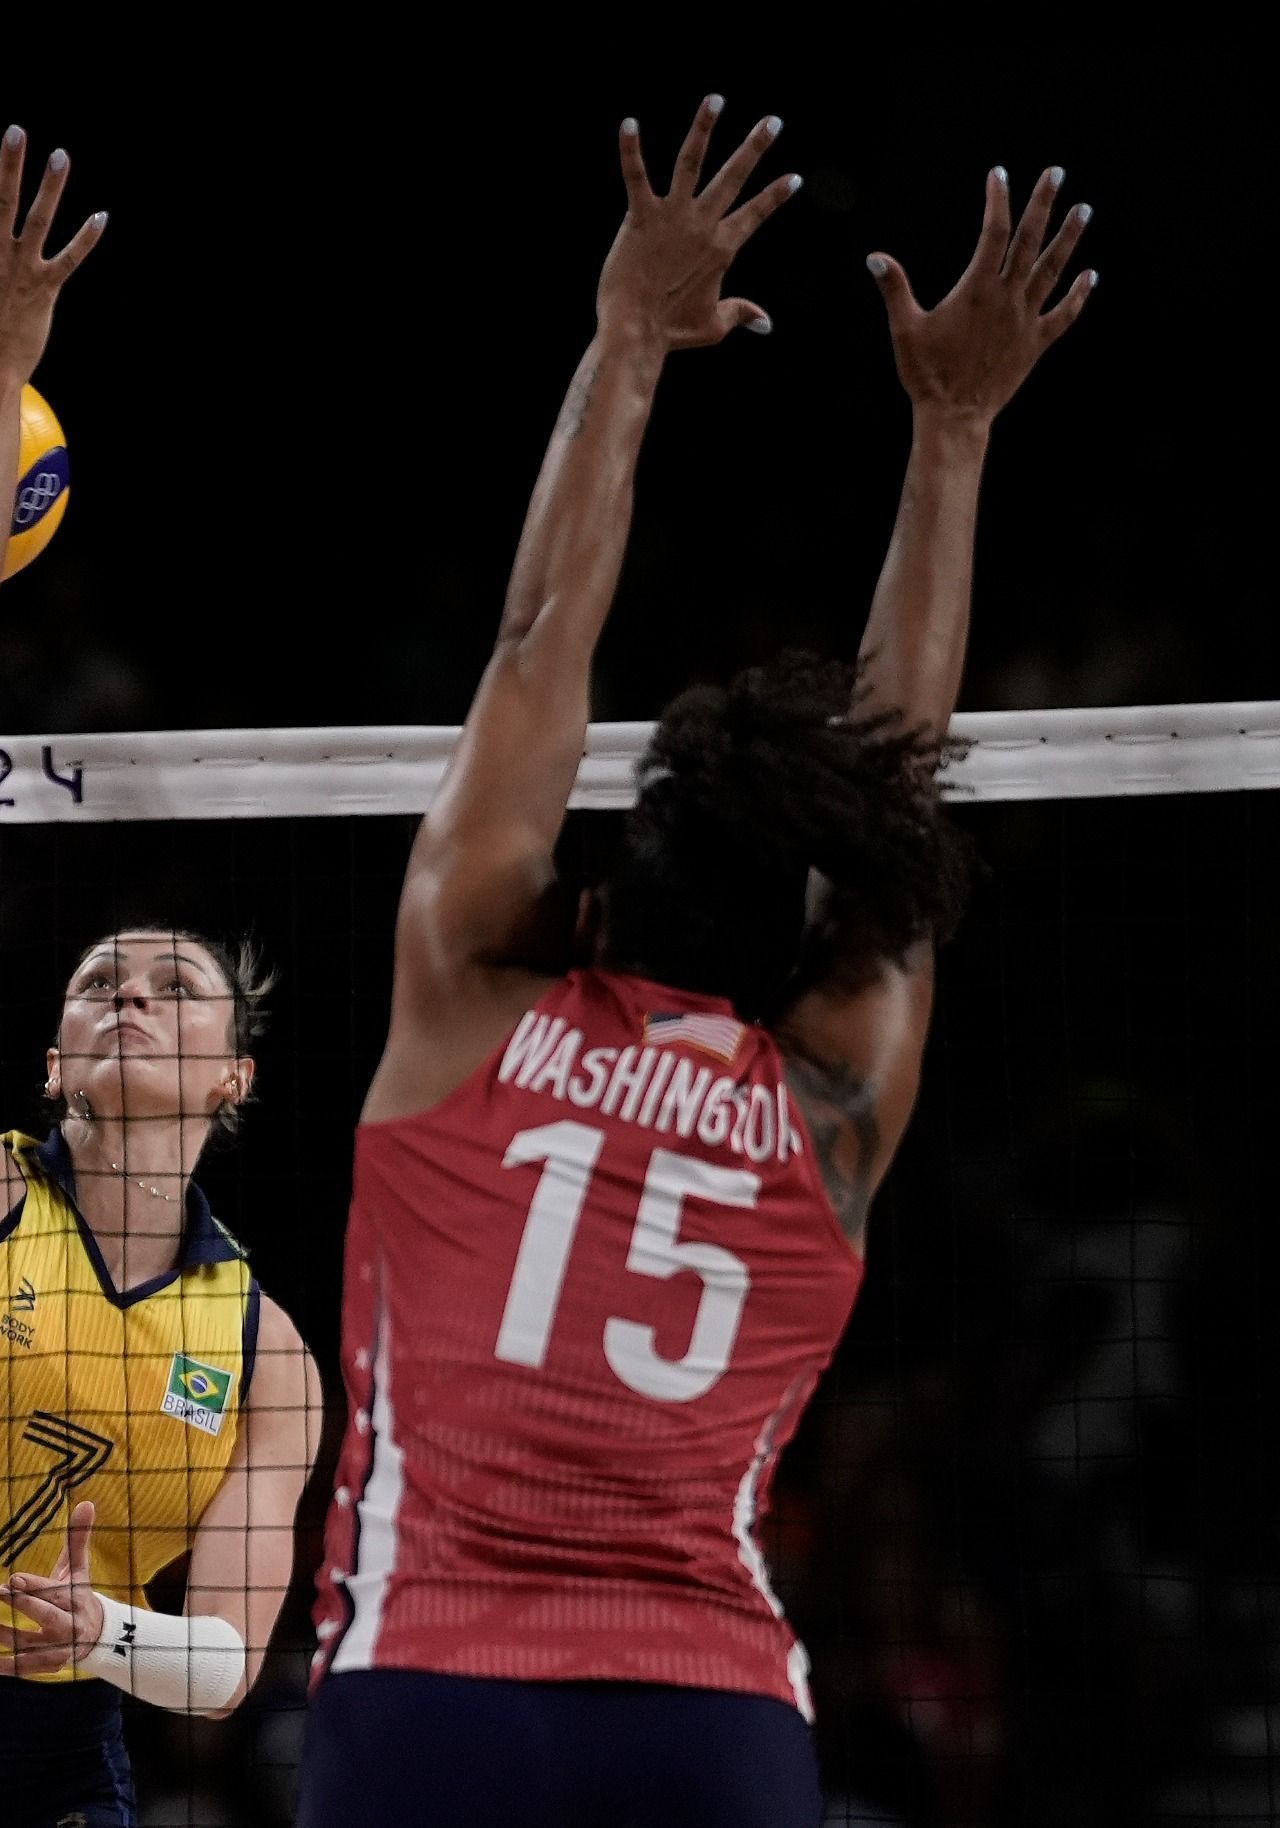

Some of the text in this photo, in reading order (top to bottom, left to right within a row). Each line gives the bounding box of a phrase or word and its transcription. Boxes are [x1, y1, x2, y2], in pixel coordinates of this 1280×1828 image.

[494, 1119, 762, 1403] 15
[1, 1313, 35, 1337] BODY
[163, 1394, 217, 1432] BRASIL
